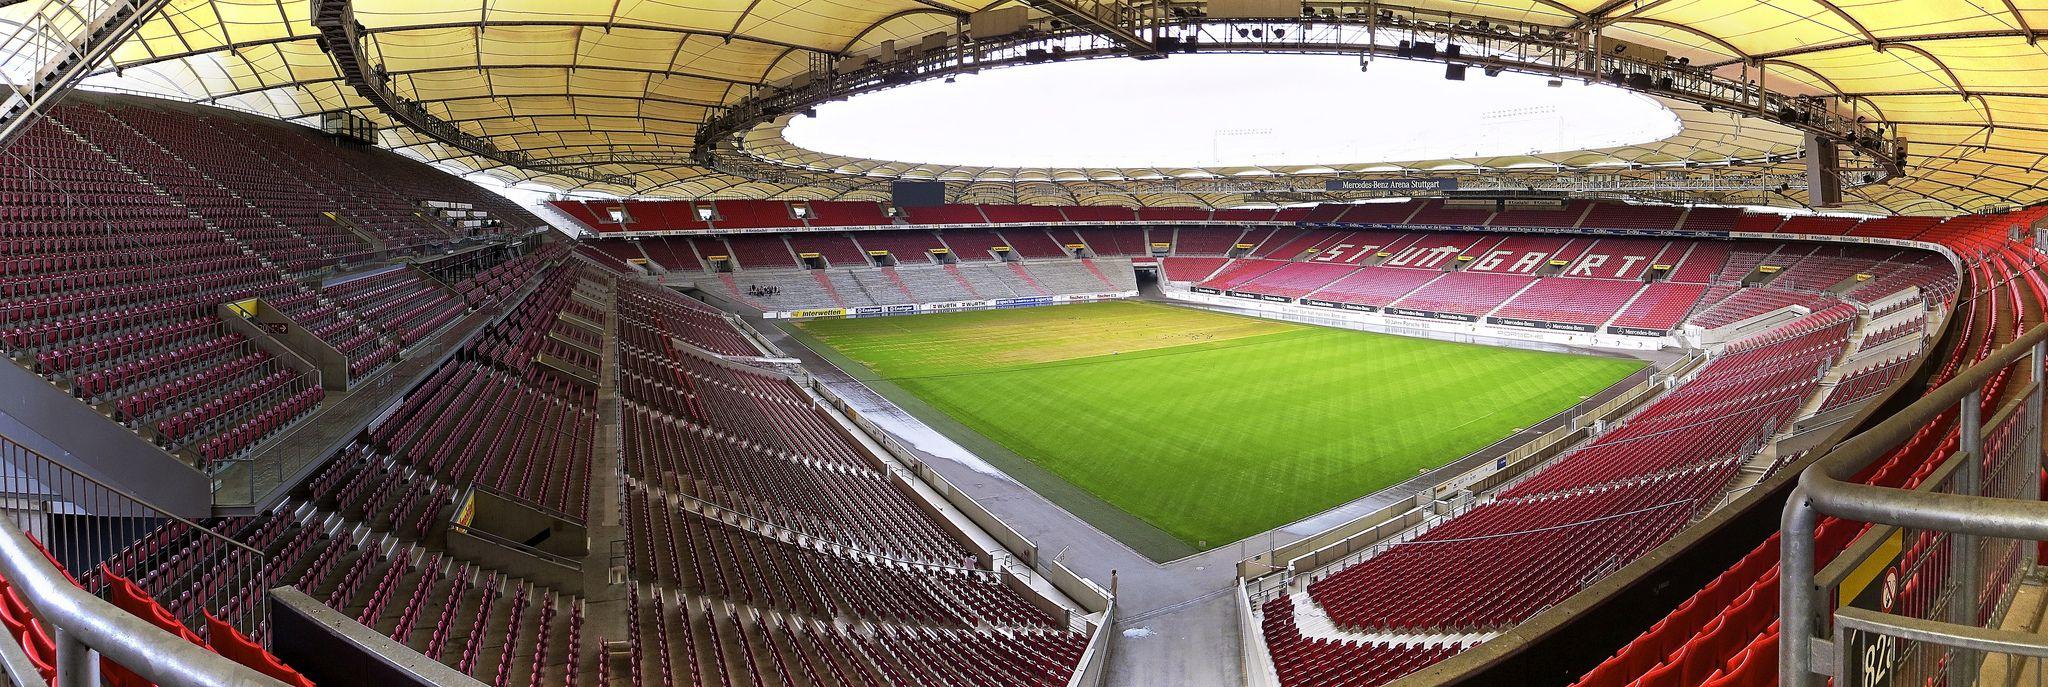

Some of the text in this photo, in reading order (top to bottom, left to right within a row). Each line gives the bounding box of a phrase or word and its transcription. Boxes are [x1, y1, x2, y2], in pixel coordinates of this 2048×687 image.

[1342, 180, 1440, 190] Mercedes-Benz Arena Stuttgart
[1504, 318, 1534, 326] Mercedes-Benz
[1552, 323, 1584, 331] Mercedes-Benz
[1625, 329, 1660, 337] Mercedes-Benz
